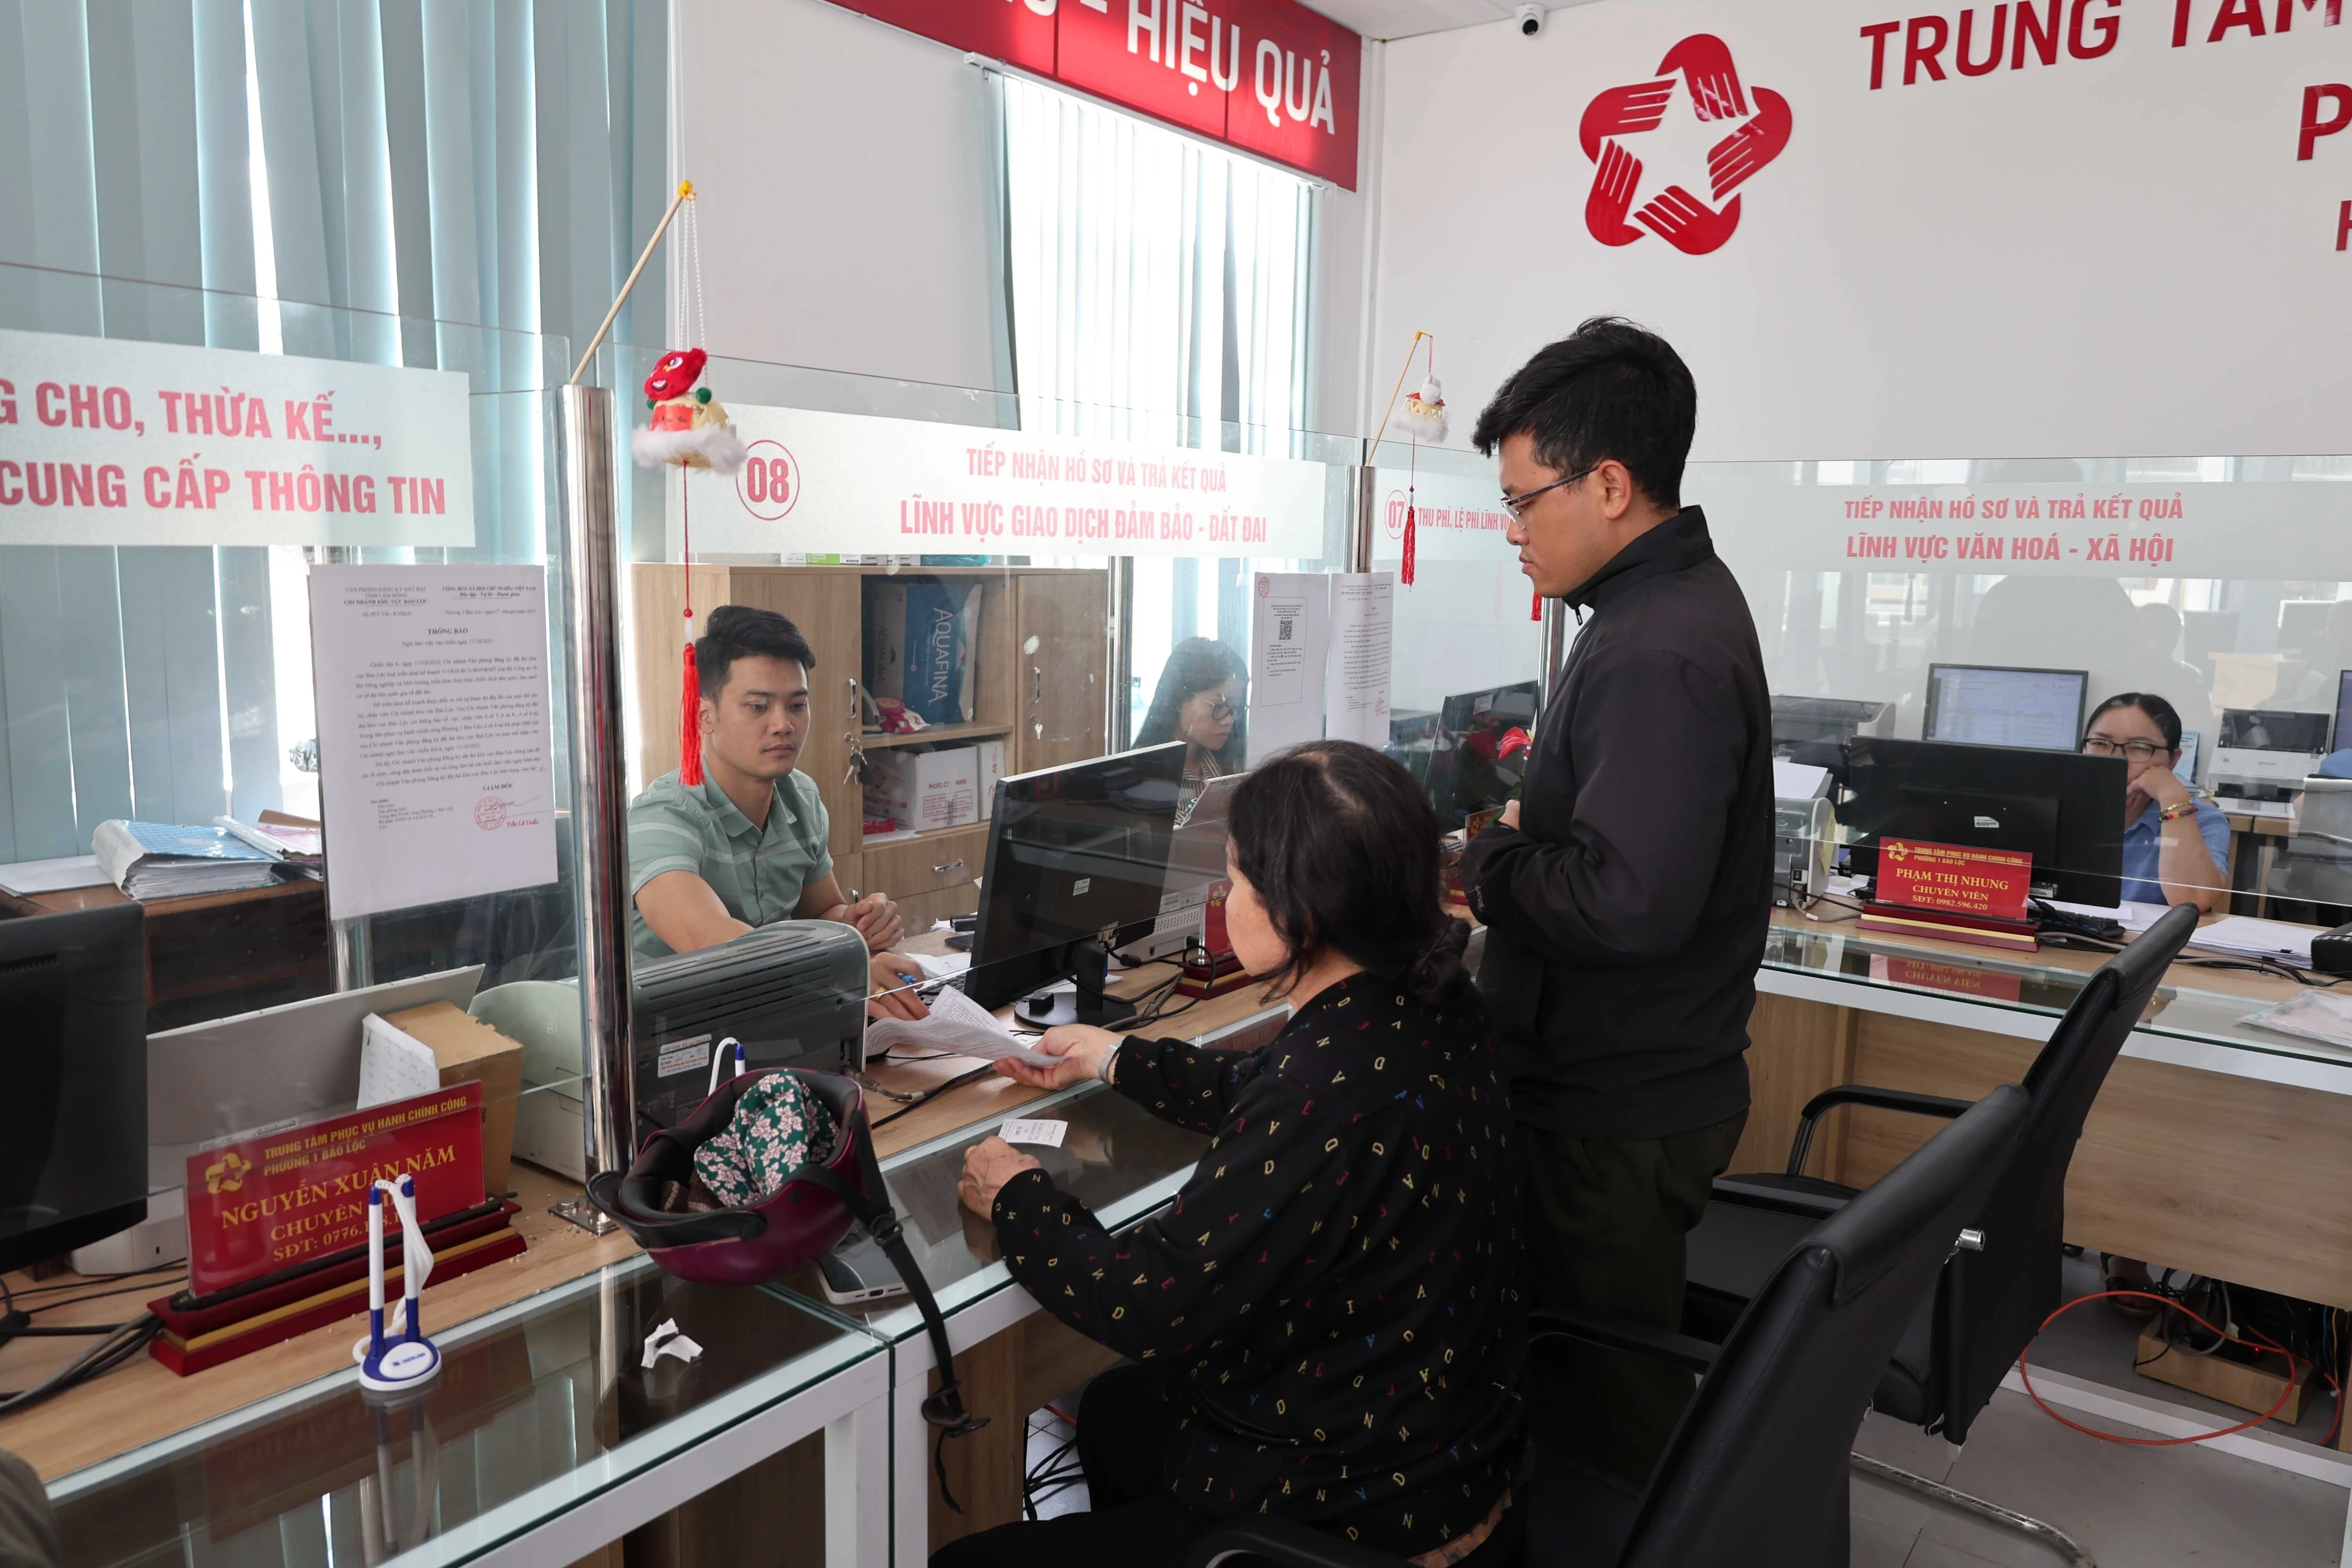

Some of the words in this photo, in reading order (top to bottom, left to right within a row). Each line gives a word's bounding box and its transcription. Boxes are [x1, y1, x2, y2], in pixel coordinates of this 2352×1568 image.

[1126, 0, 1240, 97] HIỆU
[1254, 49, 1336, 135] QUẢ
[1859, 0, 2122, 91] TRUNG
[36, 381, 145, 437] CHO,
[159, 386, 273, 439] THỪA
[285, 390, 383, 451] KẾ...,
[0, 460, 128, 508] CUNG
[144, 453, 231, 510] CẤP
[245, 464, 377, 515] THÔNG
[387, 475, 447, 516] TIN
[747, 457, 789, 504] 08
[966, 441, 1005, 477] TIẾP
[1012, 448, 1060, 486] NHẬN
[1065, 450, 1086, 483] HỒ
[1092, 457, 1113, 484] SƠ
[1117, 456, 1136, 486] VÀ
[1140, 456, 1167, 488] TRẢ
[1171, 459, 1197, 490] KẾT
[1200, 462, 1226, 494] QUẢ
[901, 494, 954, 534] LĨNH
[961, 501, 1004, 543] VỰC
[1011, 505, 1058, 537] GIAO
[1065, 507, 1109, 544] DỊCH
[1114, 500, 1154, 539] ĐẢM
[1160, 503, 1193, 541] BẢO
[1209, 505, 1238, 542] ĐẤT
[1242, 516, 1267, 543] ĐAI
[1388, 500, 1405, 529] 07
[1418, 507, 1434, 527] THU
[1454, 507, 1464, 532] LỆ
[1466, 508, 1479, 530] PHÍ
[1481, 509, 1498, 531] LĨNH
[1845, 494, 1884, 519] TIẾP
[1889, 496, 1943, 523] NHẬN
[1949, 493, 1975, 519] HỒ
[1981, 497, 2009, 519] SƠ
[2015, 495, 2040, 519] VÀ
[2047, 493, 2086, 519] TRẢ
[2092, 492, 2133, 519] KẾT
[2138, 492, 2183, 521] QUẢ
[1847, 532, 1897, 558] LĨNH
[1904, 534, 1949, 563] VỰC
[1956, 532, 2004, 559] VĂN
[2011, 532, 2060, 560] HOÁ
[2085, 533, 2120, 561] XÃ
[2129, 533, 2174, 567] HỘI
[928, 608, 953, 703] AQUAFINA
[1896, 868, 1932, 882] PHẠM
[1935, 872, 1958, 886] THỊ
[1960, 875, 2009, 890] NHUNG
[1913, 884, 1960, 898] CHUYÊN
[1962, 891, 1989, 901] VIÊN
[1912, 895, 1935, 904] SĐT:
[1936, 898, 1987, 911] 0982.596.420
[264, 1142, 301, 1159] TRUNG
[304, 1133, 328, 1151] TÂM
[330, 1126, 359, 1145] PHỤC
[361, 1121, 375, 1136] VỤ
[377, 1112, 406, 1131] HÀNH
[408, 1104, 438, 1122] CHÍNH
[440, 1096, 467, 1114] CÔNG
[321, 1146, 343, 1161] BẢO
[346, 1138, 366, 1156] LỘC
[221, 1178, 327, 1229] NGUYỄN
[335, 1161, 400, 1196] XUÂN
[405, 1144, 456, 1175] NĂM
[270, 1201, 363, 1242] CHUYÊN
[273, 1238, 318, 1262] SĐT:
